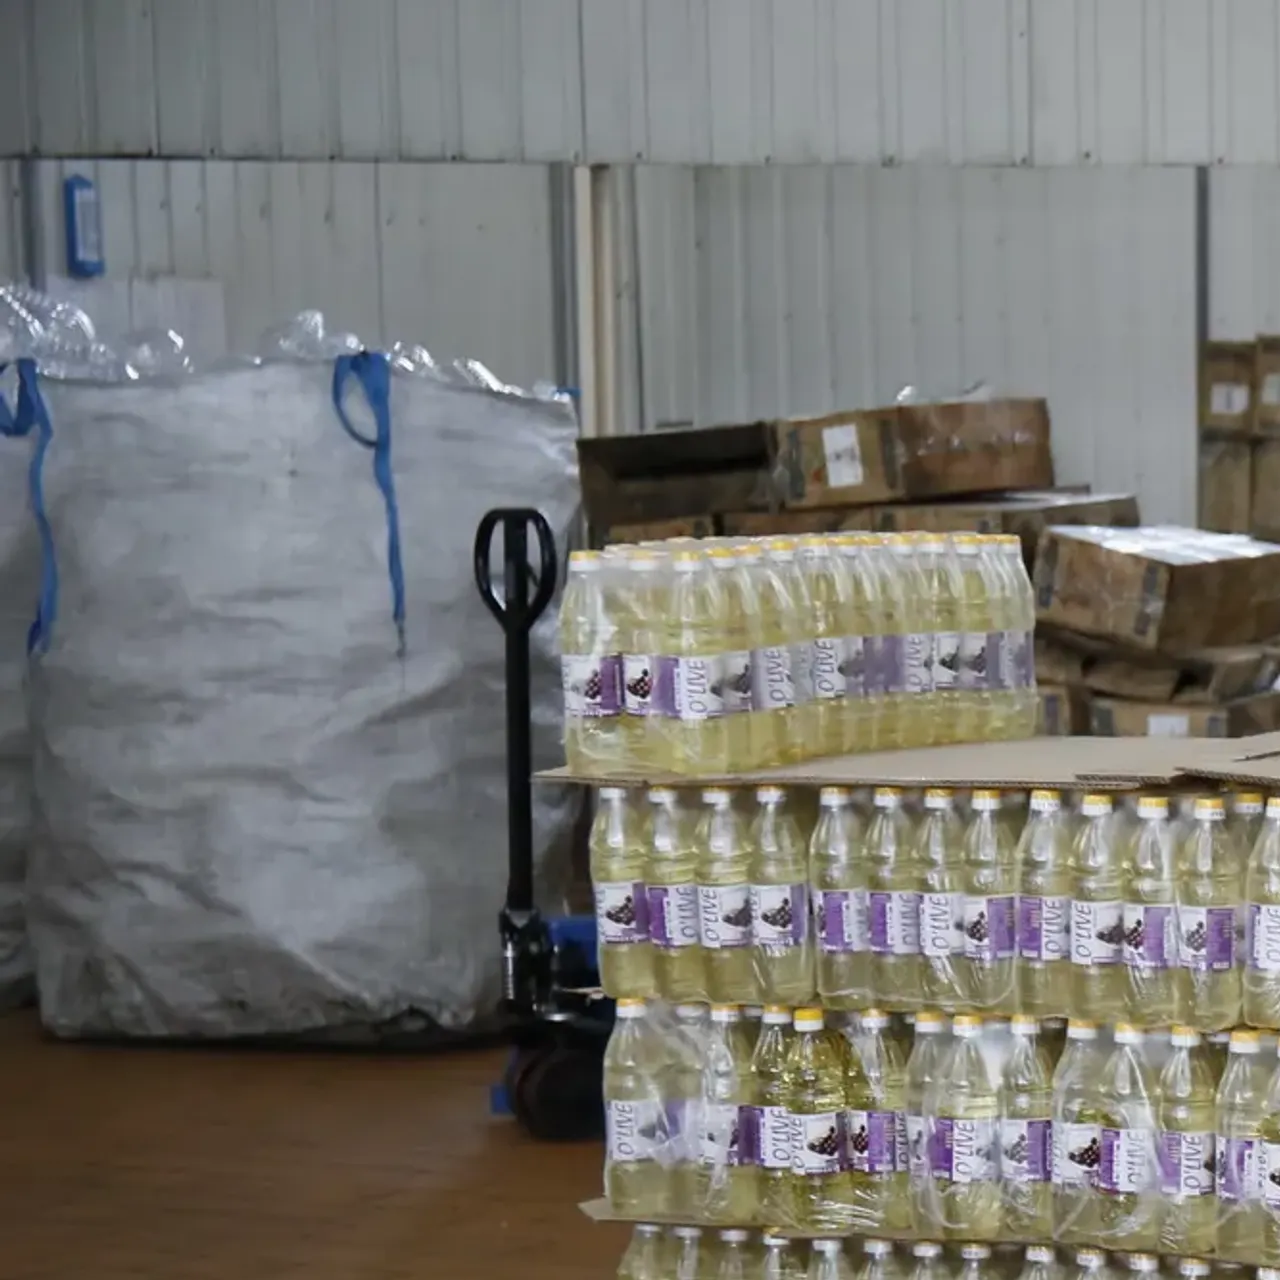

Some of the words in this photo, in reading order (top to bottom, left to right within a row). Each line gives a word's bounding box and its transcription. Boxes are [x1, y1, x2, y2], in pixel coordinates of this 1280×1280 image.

[686, 658, 708, 714] O'LIVE
[764, 648, 784, 703] O'LIVE
[815, 638, 834, 693] O'LIVE
[676, 885, 694, 939] O'LIVE
[701, 886, 720, 942] O'LIVE
[931, 894, 950, 950] O'LIVE
[1044, 898, 1063, 953] O'LIVE
[1075, 902, 1092, 958] O'LIVE
[617, 1101, 634, 1156] O'LIVE
[955, 1120, 975, 1176] O'LIVE
[1183, 1134, 1200, 1190] O'LIVE
